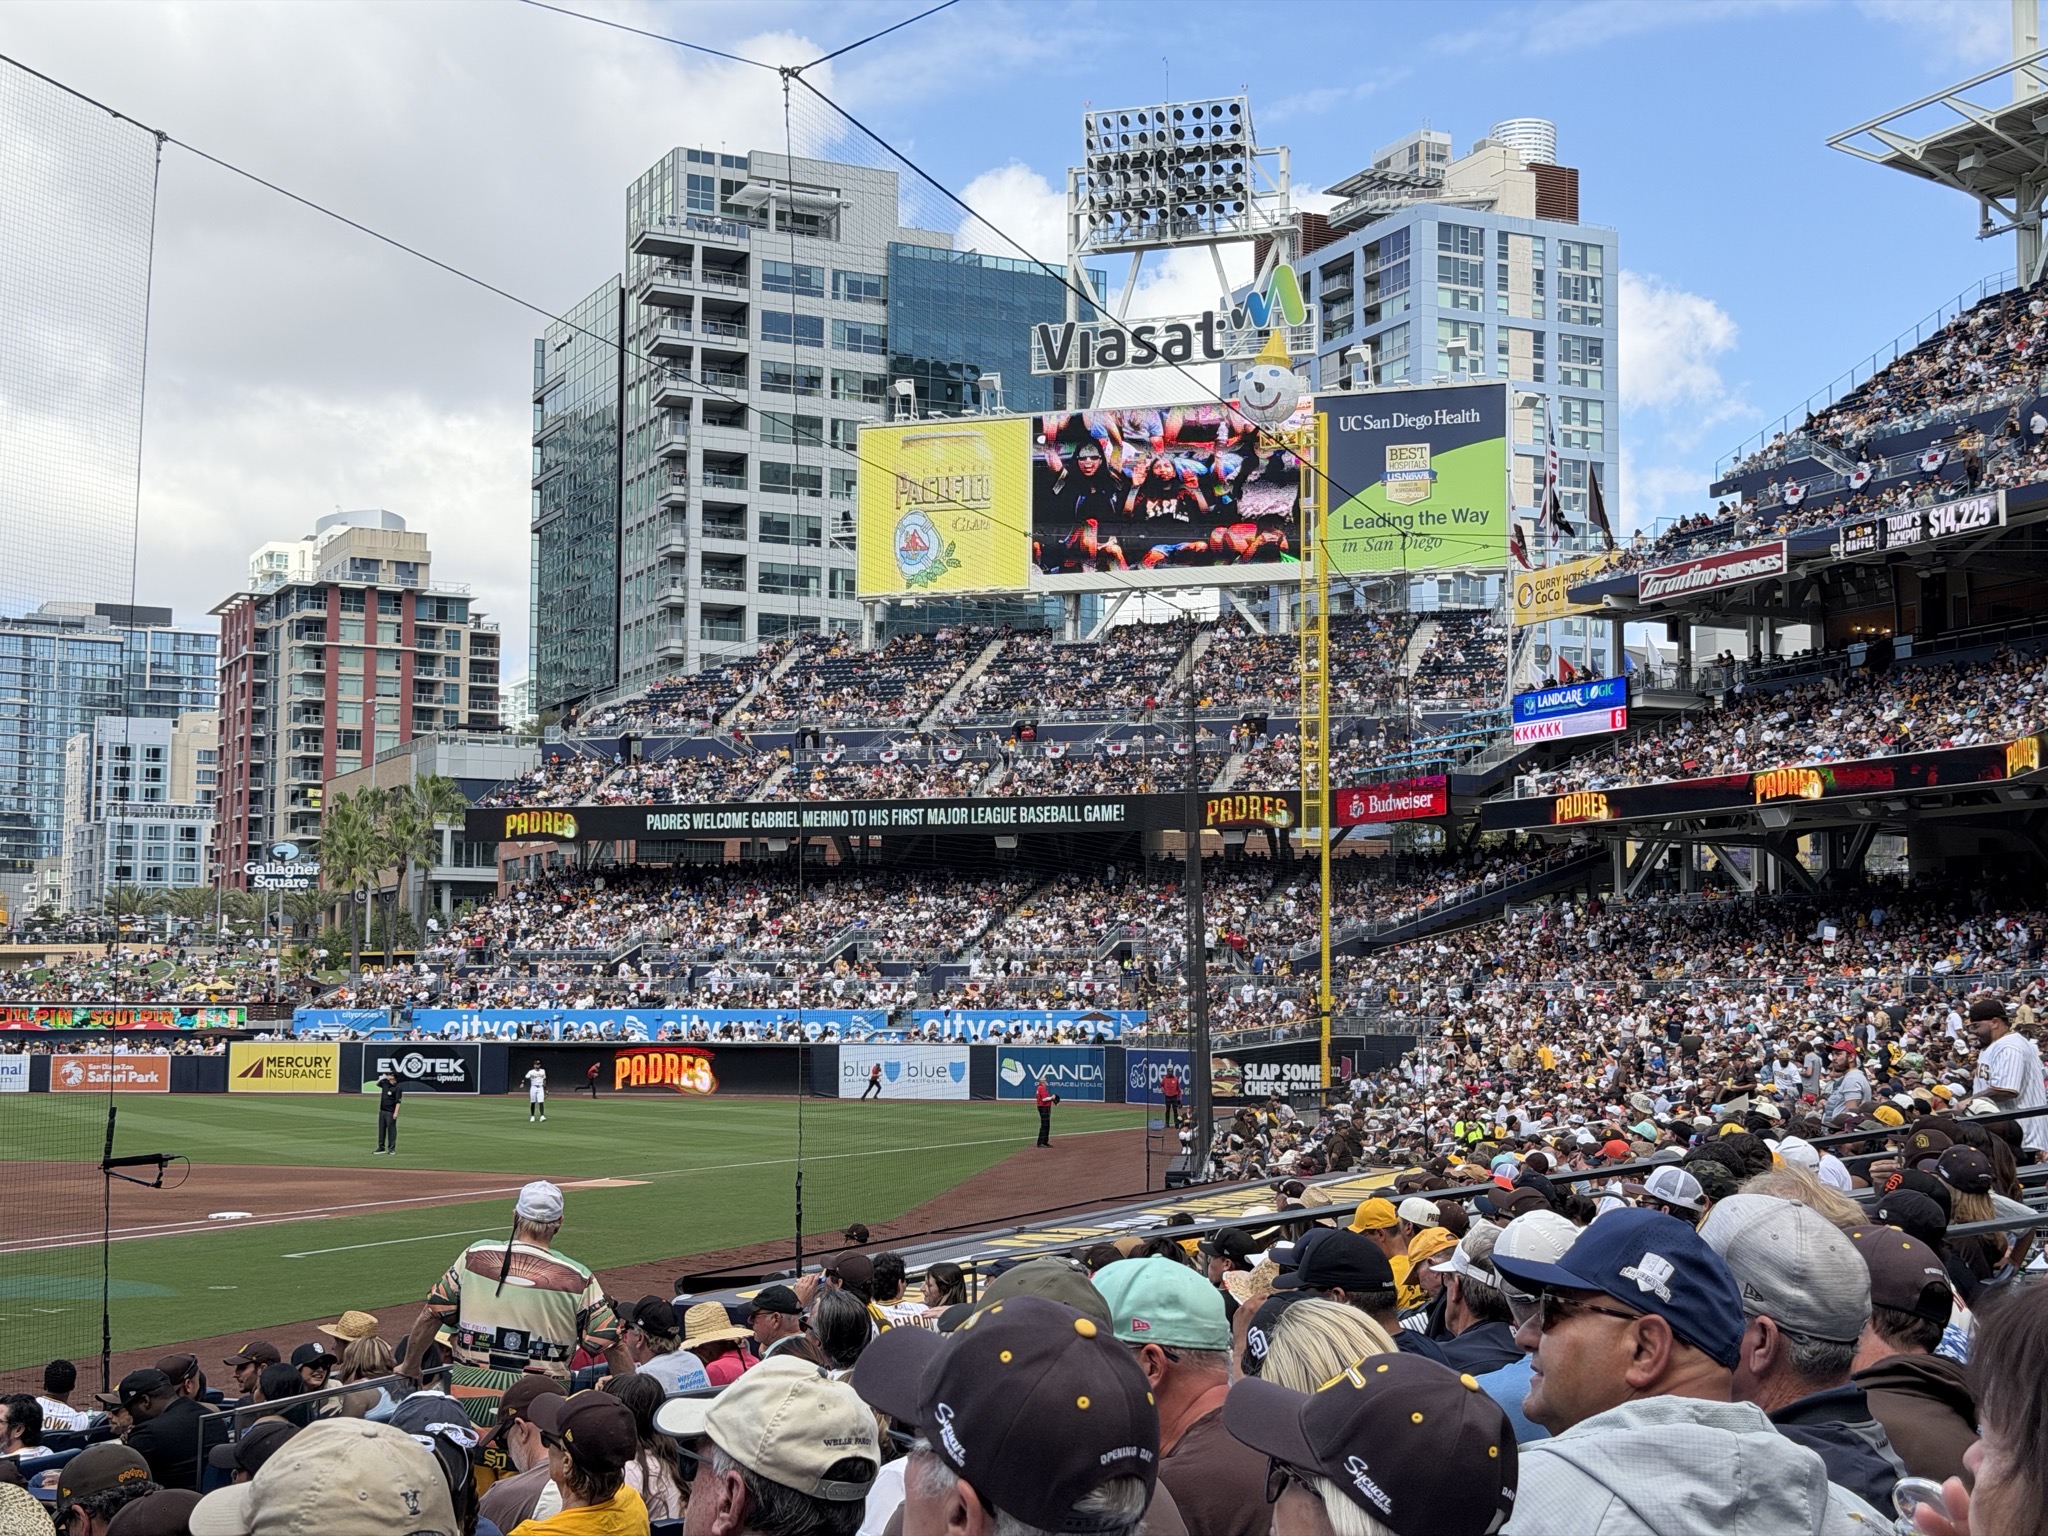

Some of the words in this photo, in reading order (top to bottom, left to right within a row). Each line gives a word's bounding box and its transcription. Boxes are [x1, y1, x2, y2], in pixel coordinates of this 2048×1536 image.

[1038, 311, 1224, 371] Viasat
[1339, 415, 1361, 431] UC
[1364, 414, 1390, 430] San
[1392, 412, 1432, 430] Diego
[1434, 408, 1480, 425] Health
[1389, 447, 1426, 460] BEST
[1388, 460, 1427, 470] HOSPITALS
[1343, 513, 1413, 530] Leading
[1418, 510, 1447, 526] the
[1451, 508, 1489, 526] Way
[1886, 511, 1922, 532] TODAY'S
[1929, 500, 1991, 538] $14,225
[1342, 542, 1357, 553] in
[1364, 537, 1393, 553] San
[1401, 535, 1443, 553] Diego
[1845, 535, 1875, 552] RAFFLE
[1887, 527, 1922, 548] JACKPOT
[1535, 576, 1561, 591] CURRY
[1563, 569, 1590, 585] HOUSE
[1641, 563, 1717, 598] Tarantino
[1717, 553, 1782, 581] SAUSAGES
[1535, 588, 1560, 604] CoCo
[1538, 688, 1583, 708] LANDCARE
[1615, 710, 1622, 727] 6
[2006, 735, 2040, 778] PADRES
[1755, 767, 1822, 804] PADRES
[1207, 795, 1290, 826] PADRES
[1369, 792, 1434, 814] Budweiser
[1555, 793, 1608, 823] PADRES
[505, 811, 578, 838] PADRES
[647, 813, 690, 830] PADRES
[693, 811, 749, 829] WELCOME
[751, 811, 800, 828] GABRIEL
[803, 810, 848, 827] MERINO
[851, 810, 866, 826] TO
[869, 809, 889, 826] HIS
[891, 808, 924, 825] FIRST
[927, 807, 967, 825] MAJOR
[971, 806, 1017, 824] LEAGUE
[1020, 805, 1081, 823] BASEBALL
[1084, 804, 1125, 822] GAME!
[243, 862, 320, 877] Gallagher
[254, 876, 309, 890] Square
[444, 1014, 615, 1038] citycises
[1, 1063, 22, 1075] nal
[102, 1064, 120, 1072] Diego
[266, 1056, 332, 1068] MERCURY
[377, 1054, 465, 1077] EVOTEK
[844, 1061, 872, 1077] blu
[908, 1062, 947, 1077] blue
[87, 1071, 127, 1083] Safari
[129, 1072, 159, 1083] Park
[266, 1068, 332, 1079] INSURANCE
[437, 1073, 464, 1084] upwind
[615, 1052, 716, 1092] PADRES
[1027, 1063, 1103, 1080] VANDA
[1244, 1063, 1280, 1080] SLAP
[1282, 1064, 1322, 1081] SOME
[1244, 1081, 1289, 1096] CHEESE
[1427, 1213, 1440, 1222] PAD
[823, 1438, 852, 1447] WELLS
[1100, 1446, 1137, 1465] OPENING
[1140, 1448, 1153, 1463] DAY
[1343, 1455, 1391, 1508] Sycuan
